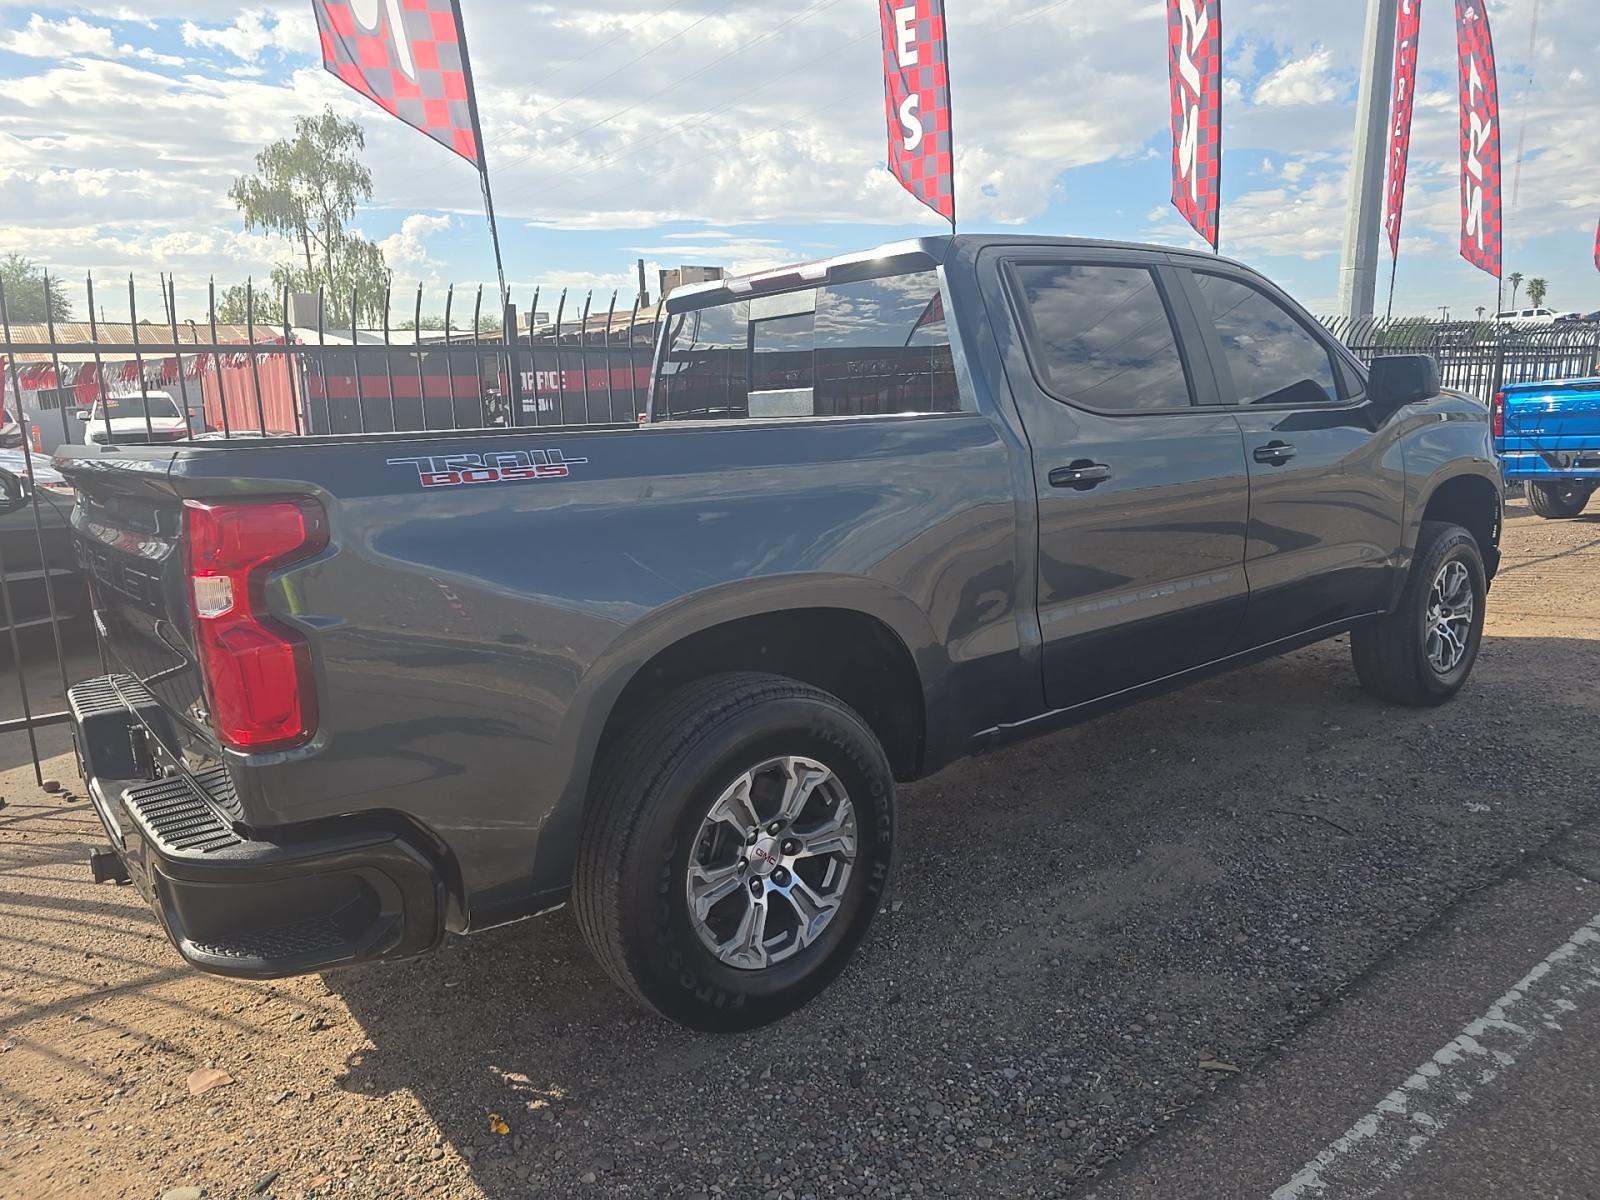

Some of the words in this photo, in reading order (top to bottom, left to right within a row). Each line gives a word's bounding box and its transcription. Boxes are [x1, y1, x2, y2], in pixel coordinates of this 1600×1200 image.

[386, 448, 589, 474] TRAIL
[419, 463, 570, 488] BOSS
[755, 847, 777, 866] GMC
